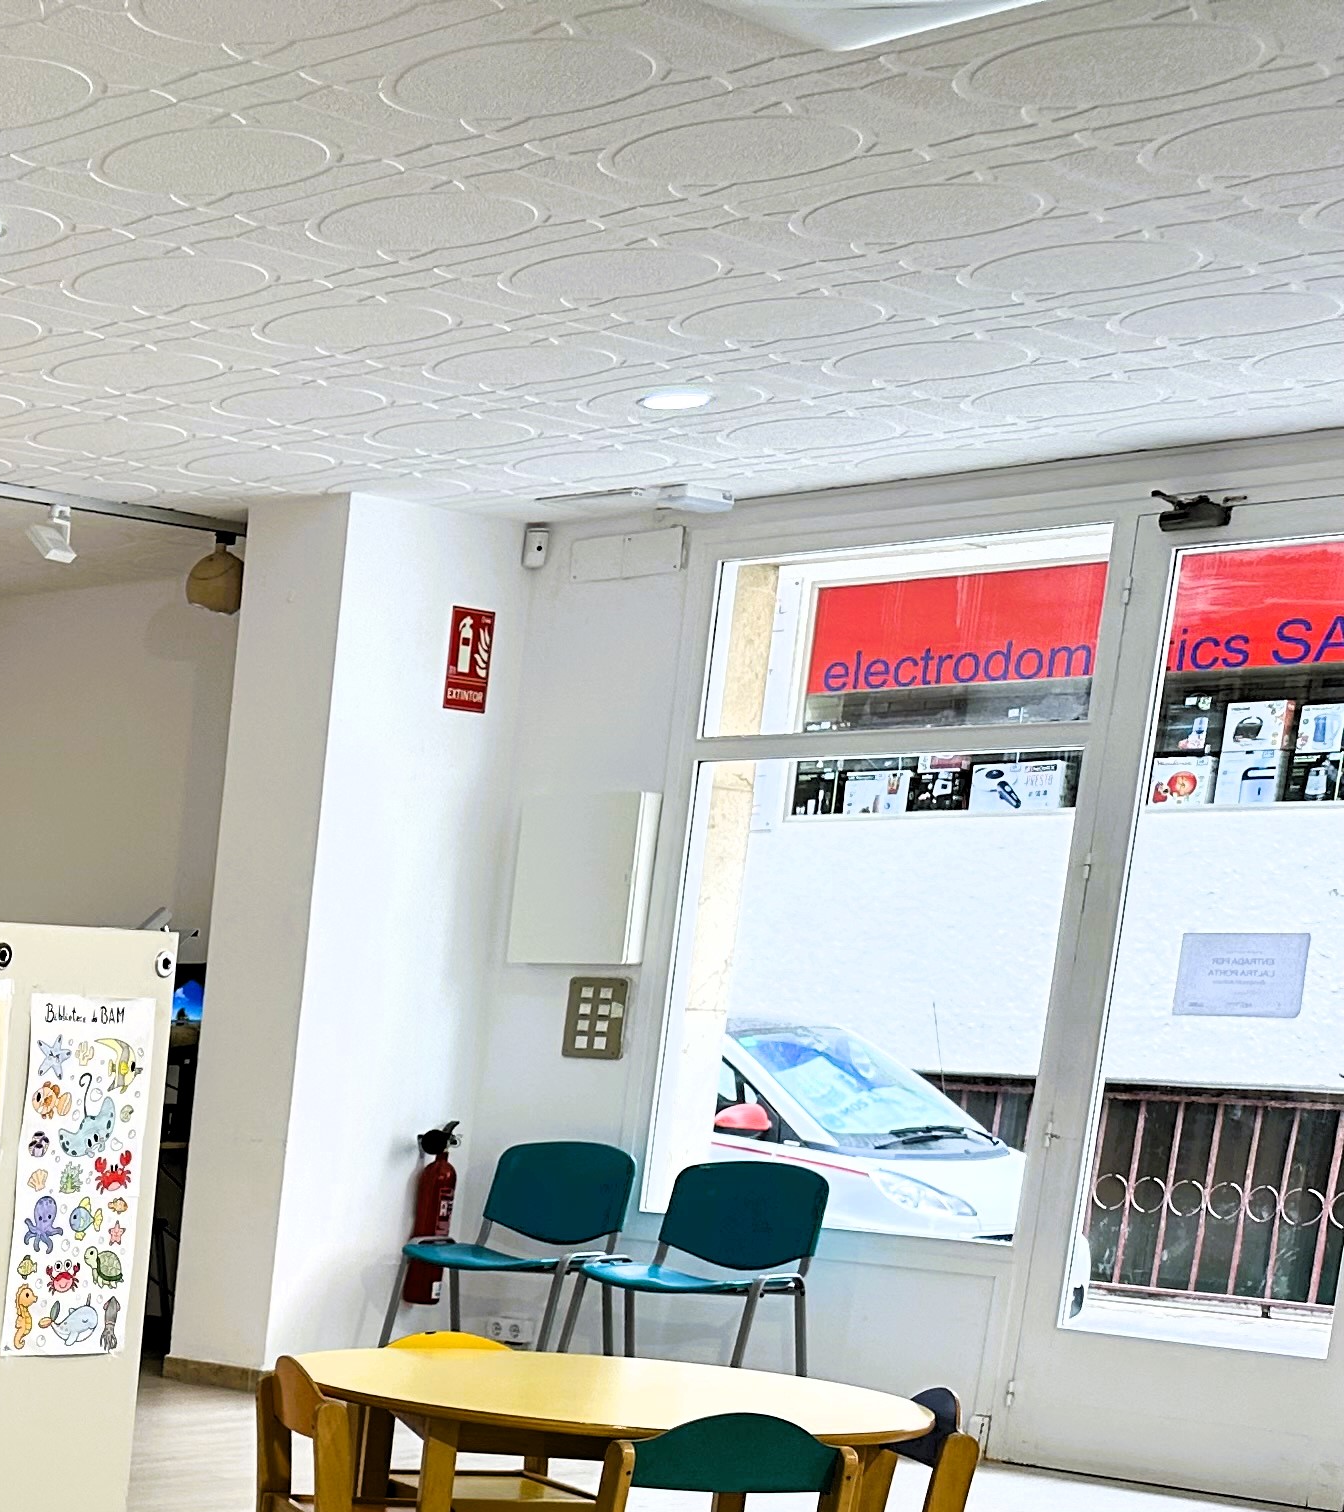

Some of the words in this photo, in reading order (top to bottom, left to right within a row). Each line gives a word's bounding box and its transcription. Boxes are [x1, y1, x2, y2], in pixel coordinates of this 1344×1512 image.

[1165, 627, 1250, 672] ics
[446, 687, 484, 703] EXTINTOR
[100, 1005, 126, 1025] BAM
